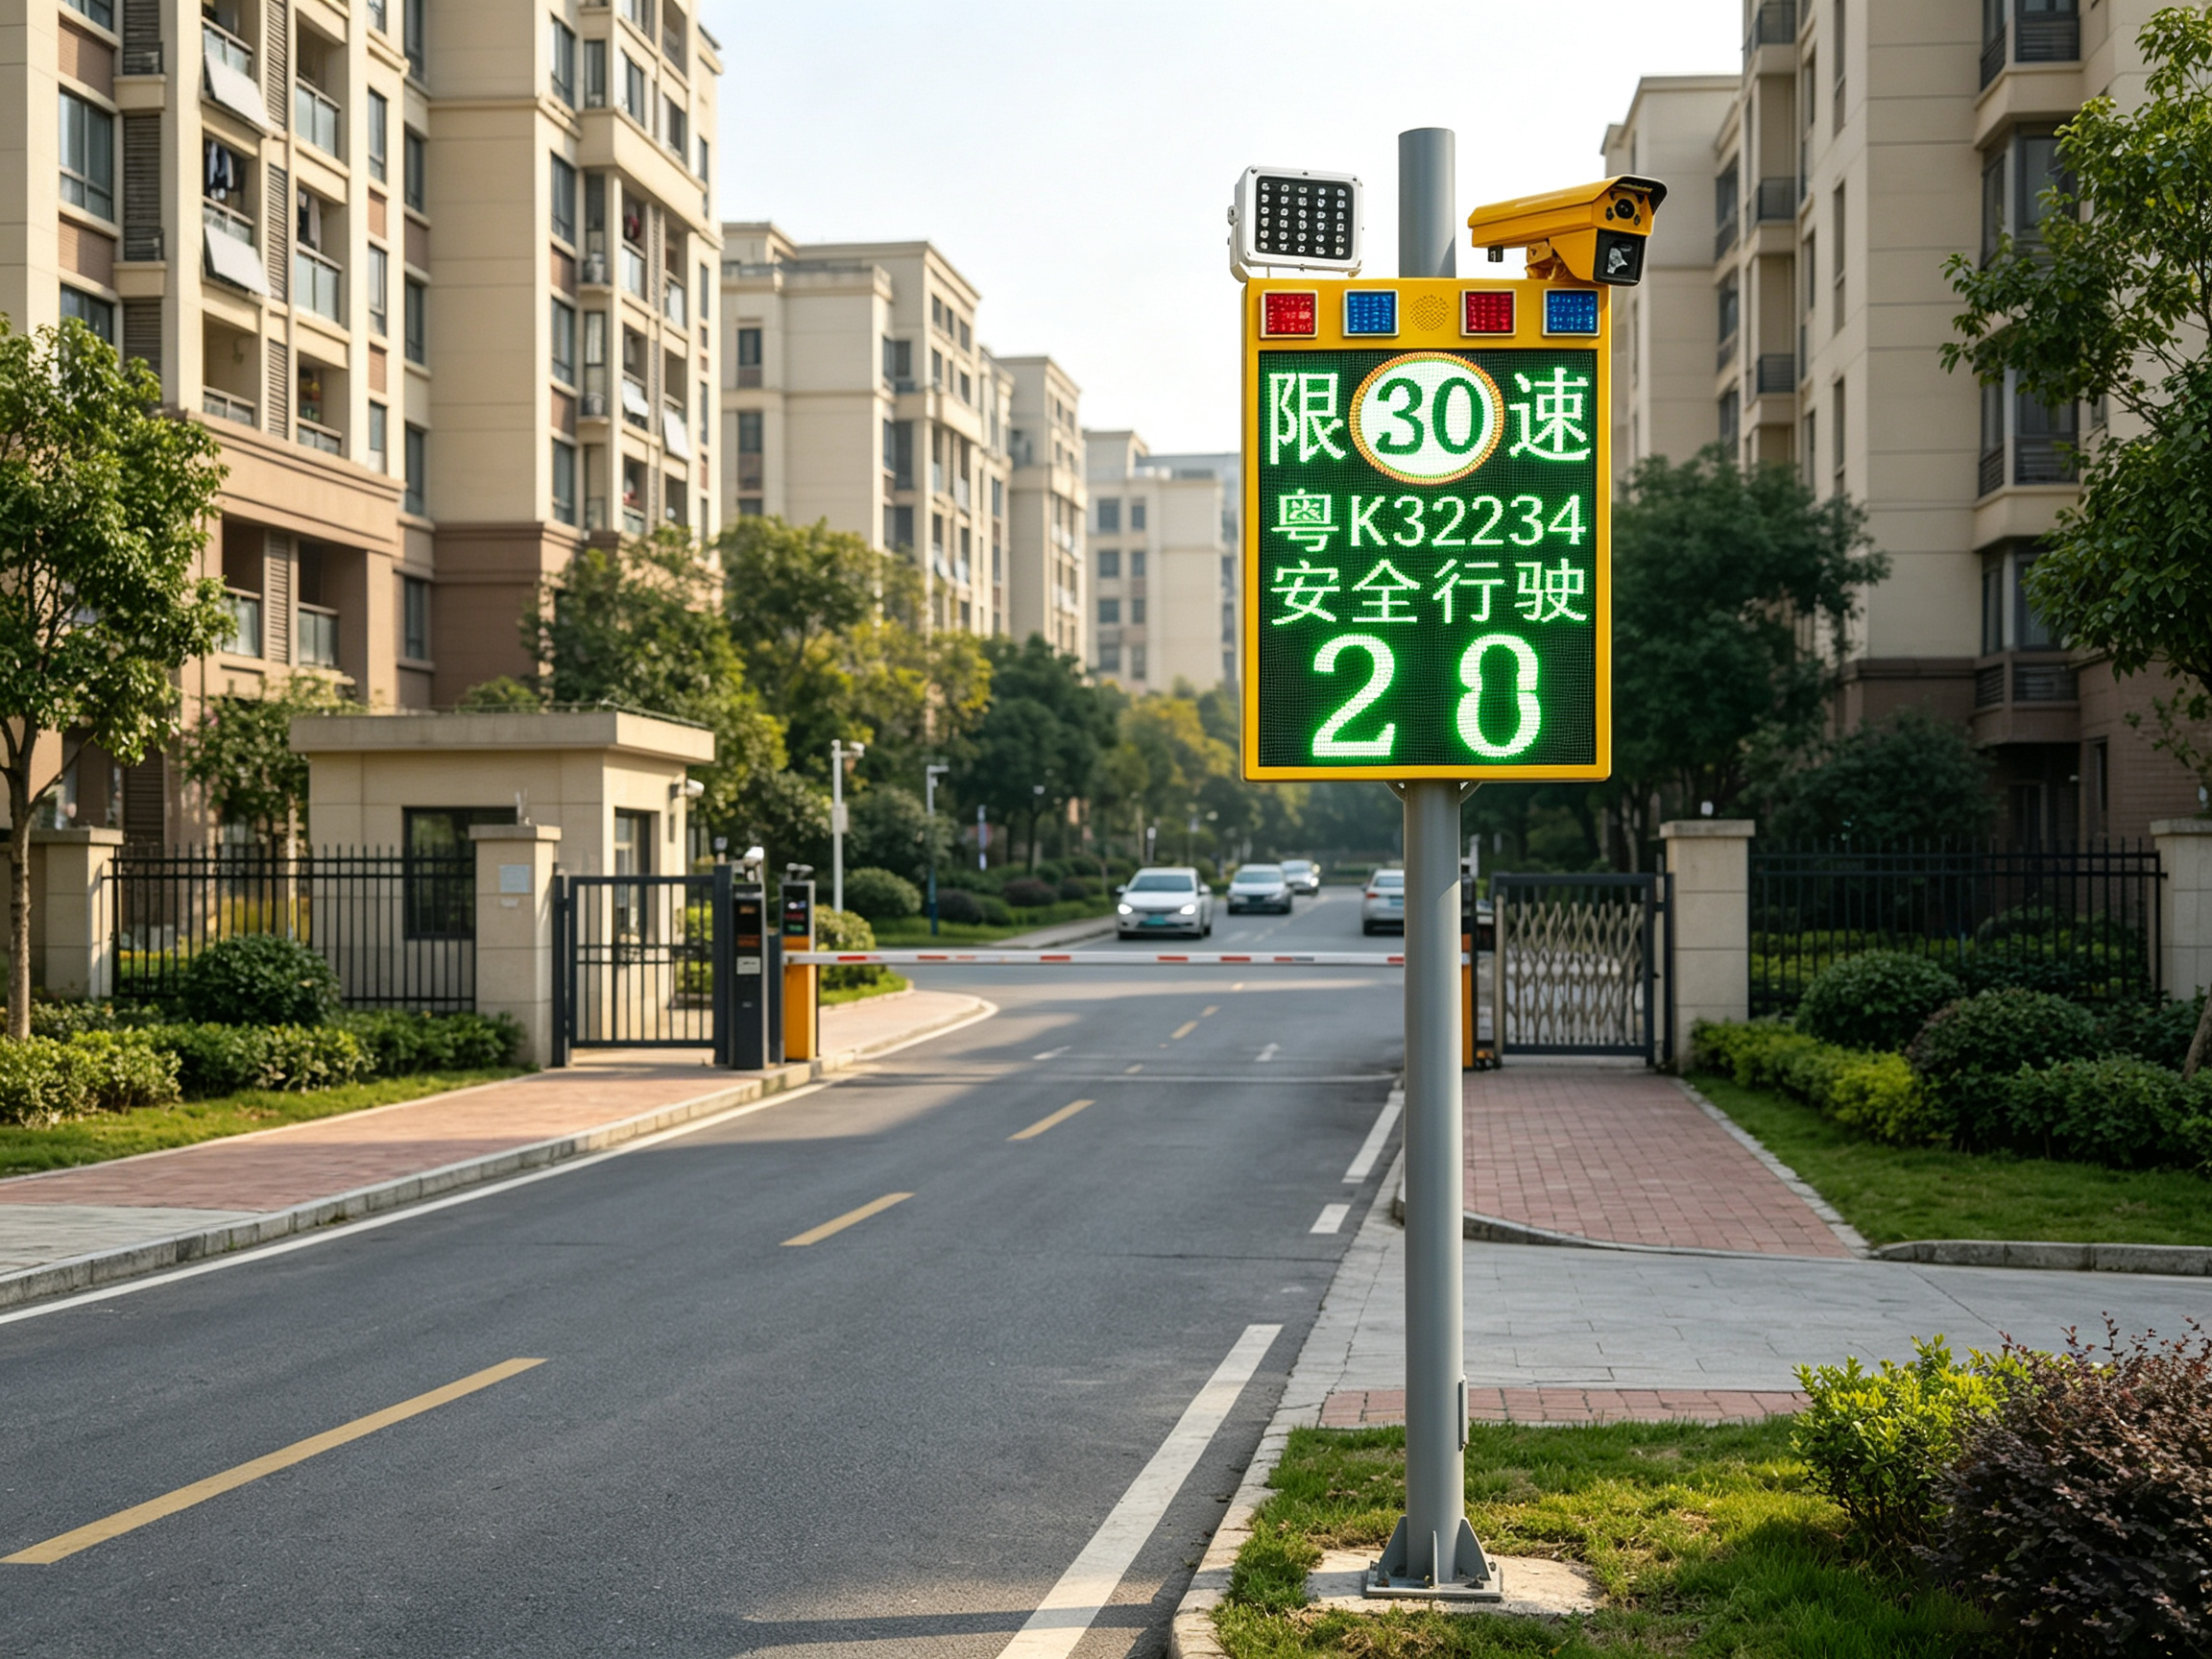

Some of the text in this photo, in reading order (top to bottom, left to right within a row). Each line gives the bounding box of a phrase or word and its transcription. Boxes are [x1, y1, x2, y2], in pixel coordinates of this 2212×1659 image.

[1268, 367, 1591, 465] 限 30 速
[1270, 558, 1587, 624] 安全行驶
